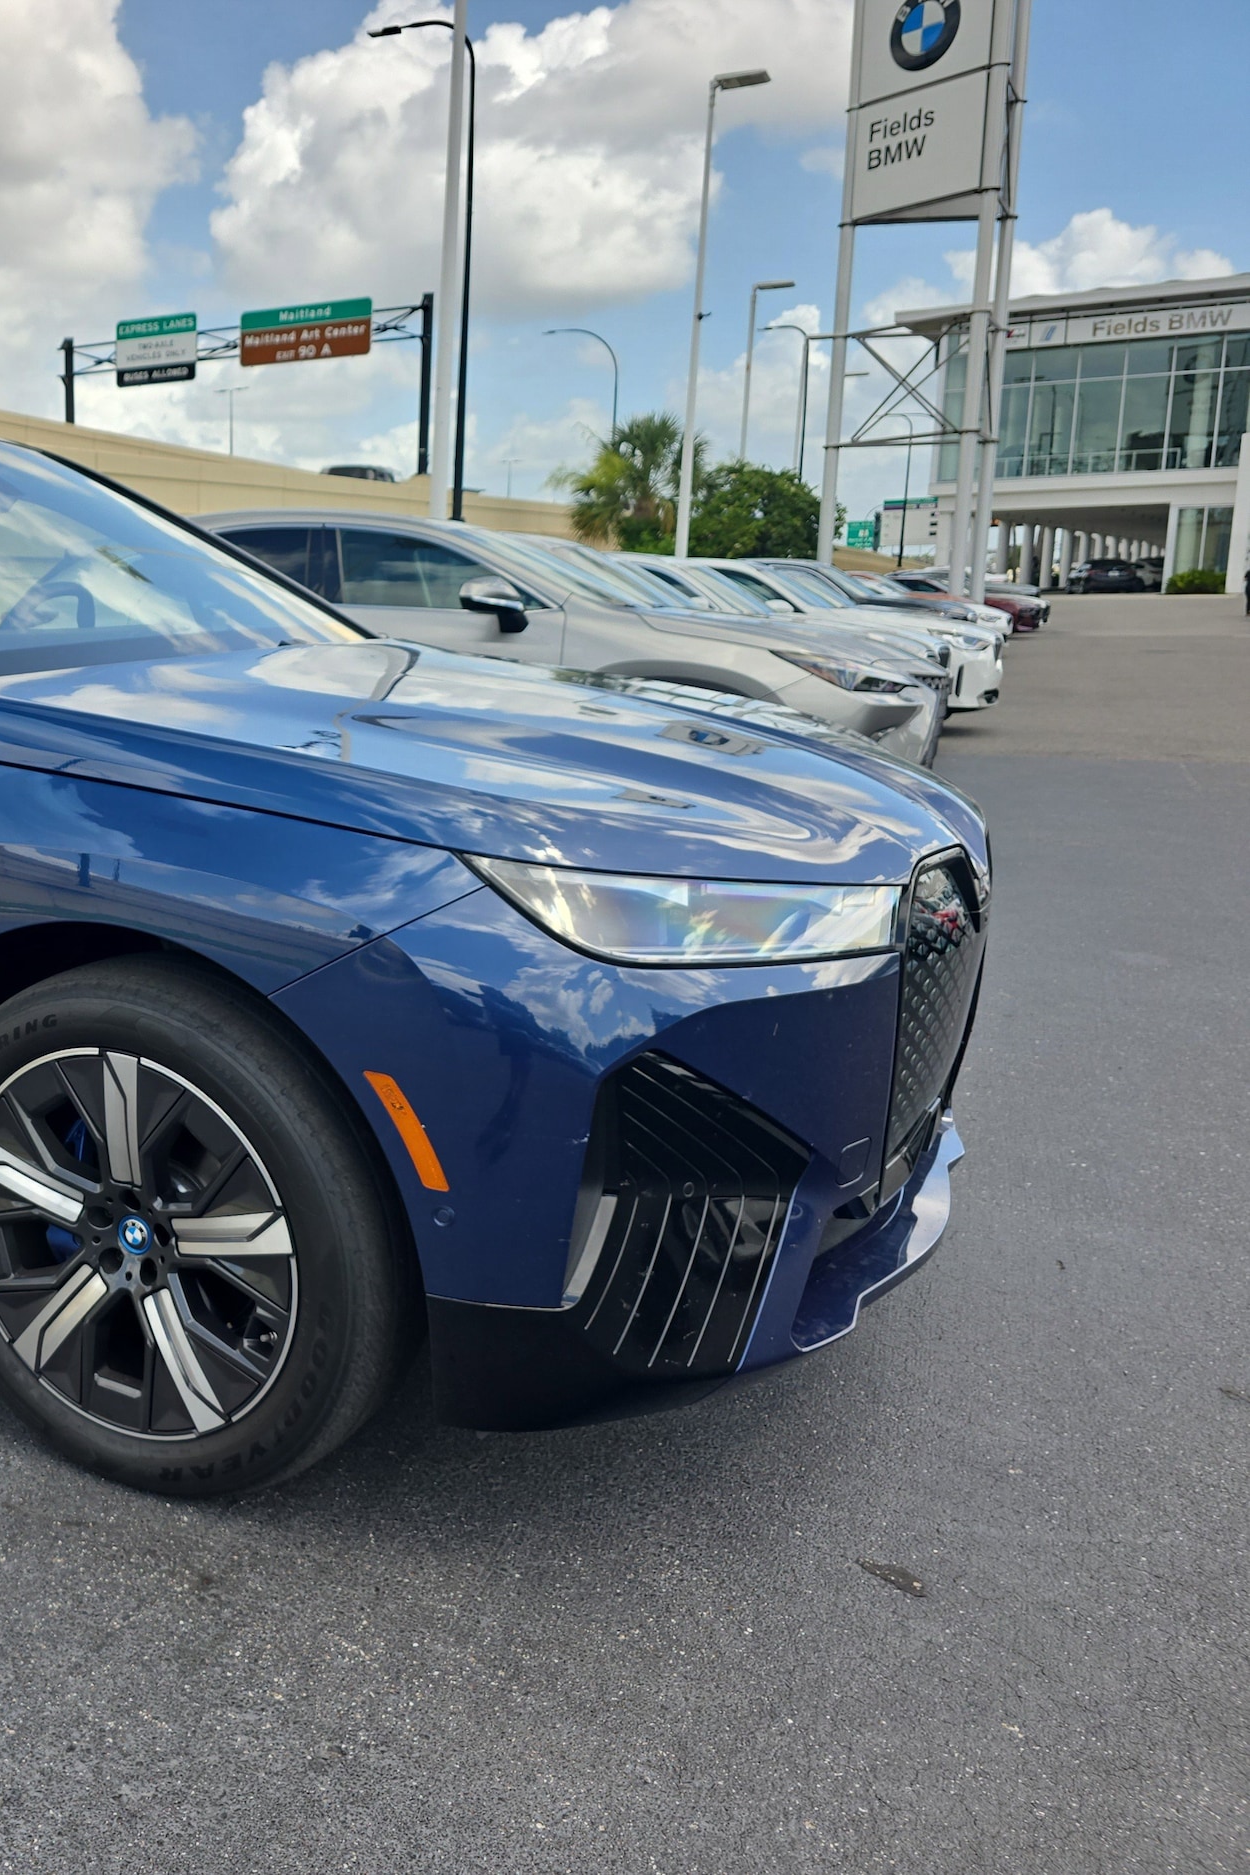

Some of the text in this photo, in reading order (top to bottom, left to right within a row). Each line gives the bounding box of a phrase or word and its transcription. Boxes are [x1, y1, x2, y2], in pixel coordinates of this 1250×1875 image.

[869, 107, 935, 143] Fields
[867, 134, 926, 170] BMW
[279, 306, 332, 321] Maitland
[1092, 308, 1233, 337] Fields BMW
[118, 317, 195, 335] EXPRESS LANES
[244, 324, 367, 347] Maitland Art Center
[297, 344, 317, 359] 90
[320, 342, 332, 357] A
[151, 366, 190, 379] ALLOWED
